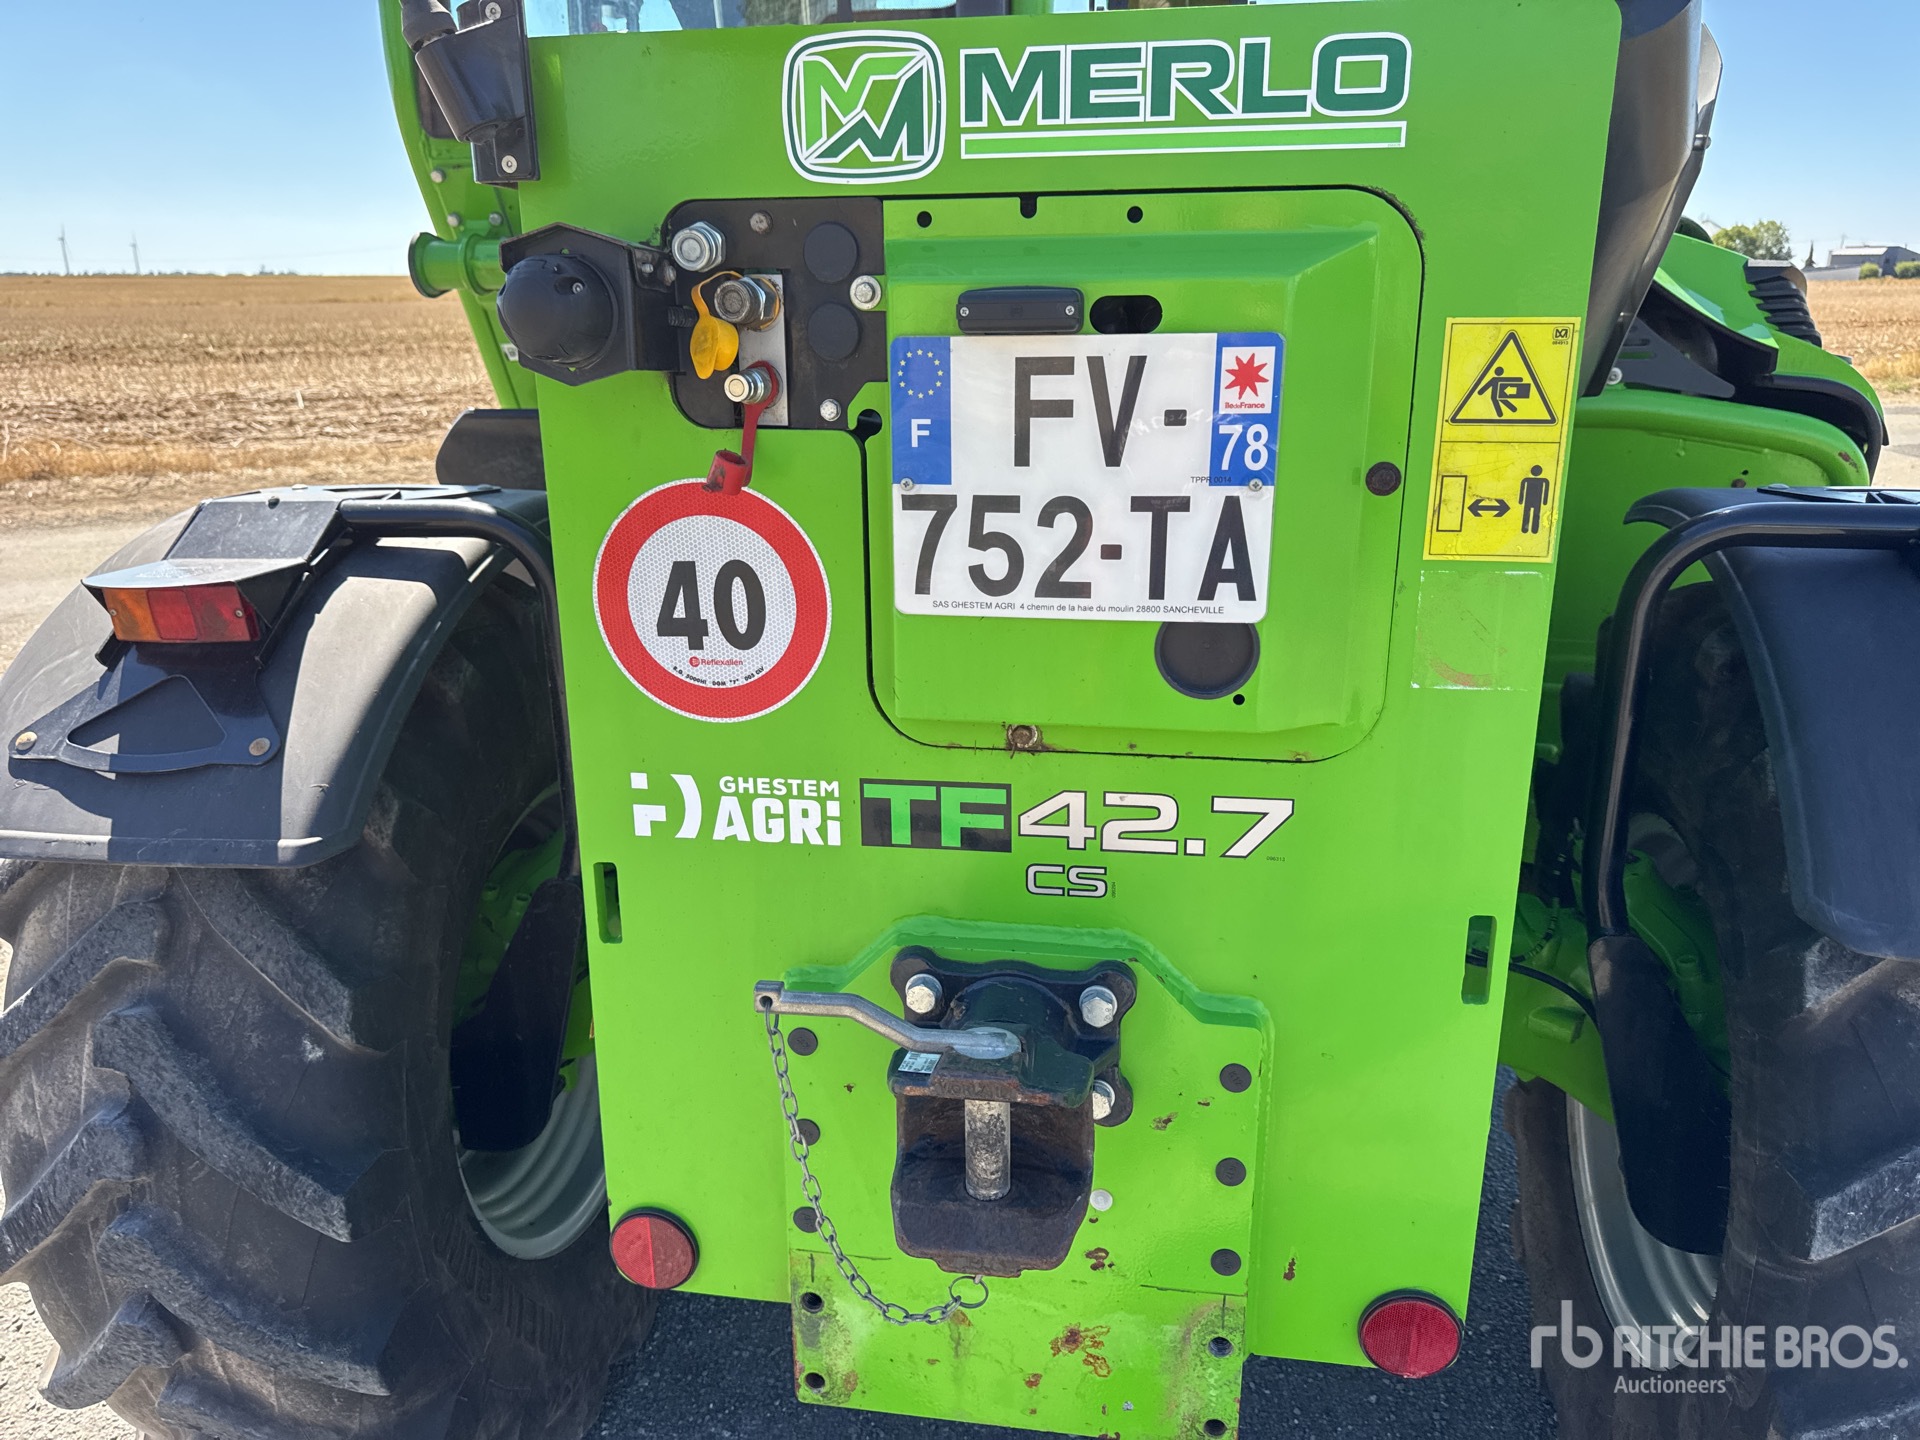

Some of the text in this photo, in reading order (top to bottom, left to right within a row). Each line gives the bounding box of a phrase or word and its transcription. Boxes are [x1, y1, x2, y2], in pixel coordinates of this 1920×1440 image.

[960, 32, 1412, 126] MERLO
[911, 419, 931, 448] F
[1219, 424, 1268, 470] 78
[901, 494, 1256, 601] 752-TA
[657, 559, 766, 650] 40
[951, 601, 992, 609] GHESTEM
[995, 602, 1016, 610] AGRI
[1027, 603, 1054, 611] chemin
[1108, 605, 1134, 613] moulin
[1136, 605, 1161, 613] 28800
[1163, 605, 1224, 614] SANCHEVILLE
[719, 775, 840, 798] GHESTEM
[863, 783, 1295, 858] TF 42.7
[1026, 863, 1108, 898] CS
